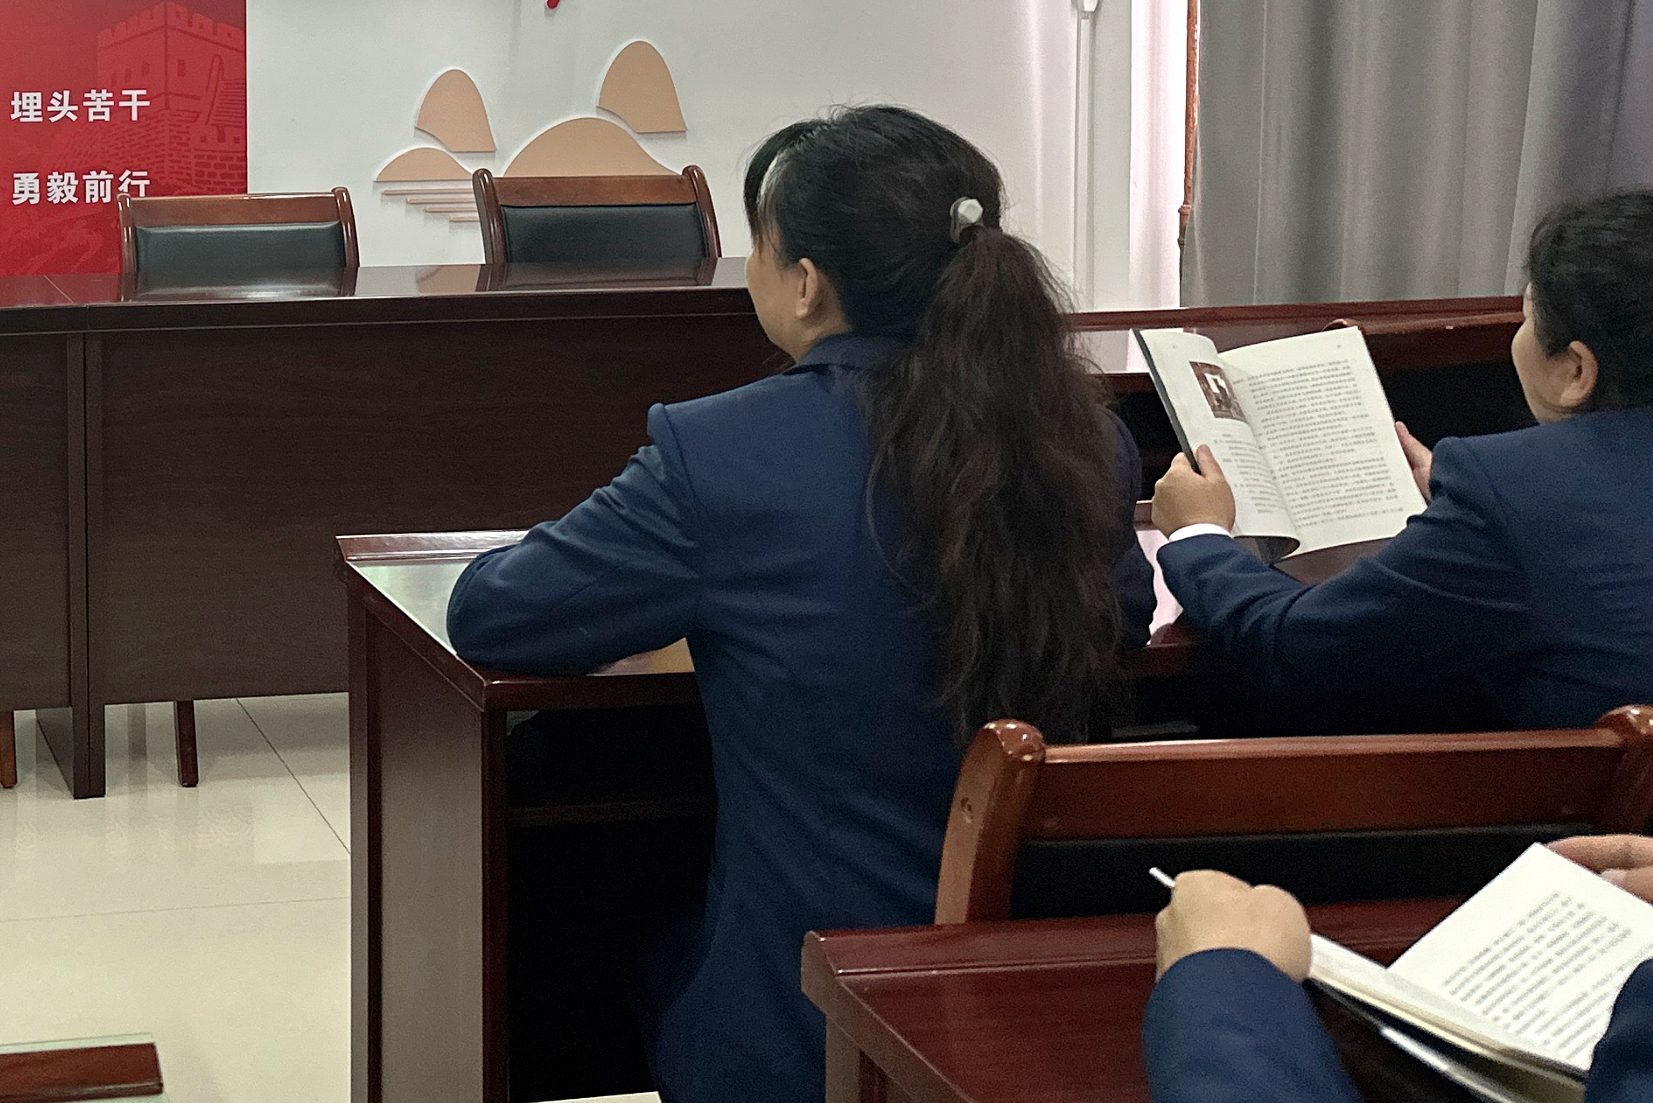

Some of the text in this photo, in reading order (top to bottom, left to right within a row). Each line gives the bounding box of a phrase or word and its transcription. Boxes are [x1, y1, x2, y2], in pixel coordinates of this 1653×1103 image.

[10, 89, 150, 123] 埋头苦干
[11, 169, 150, 205] 勇毅前行
